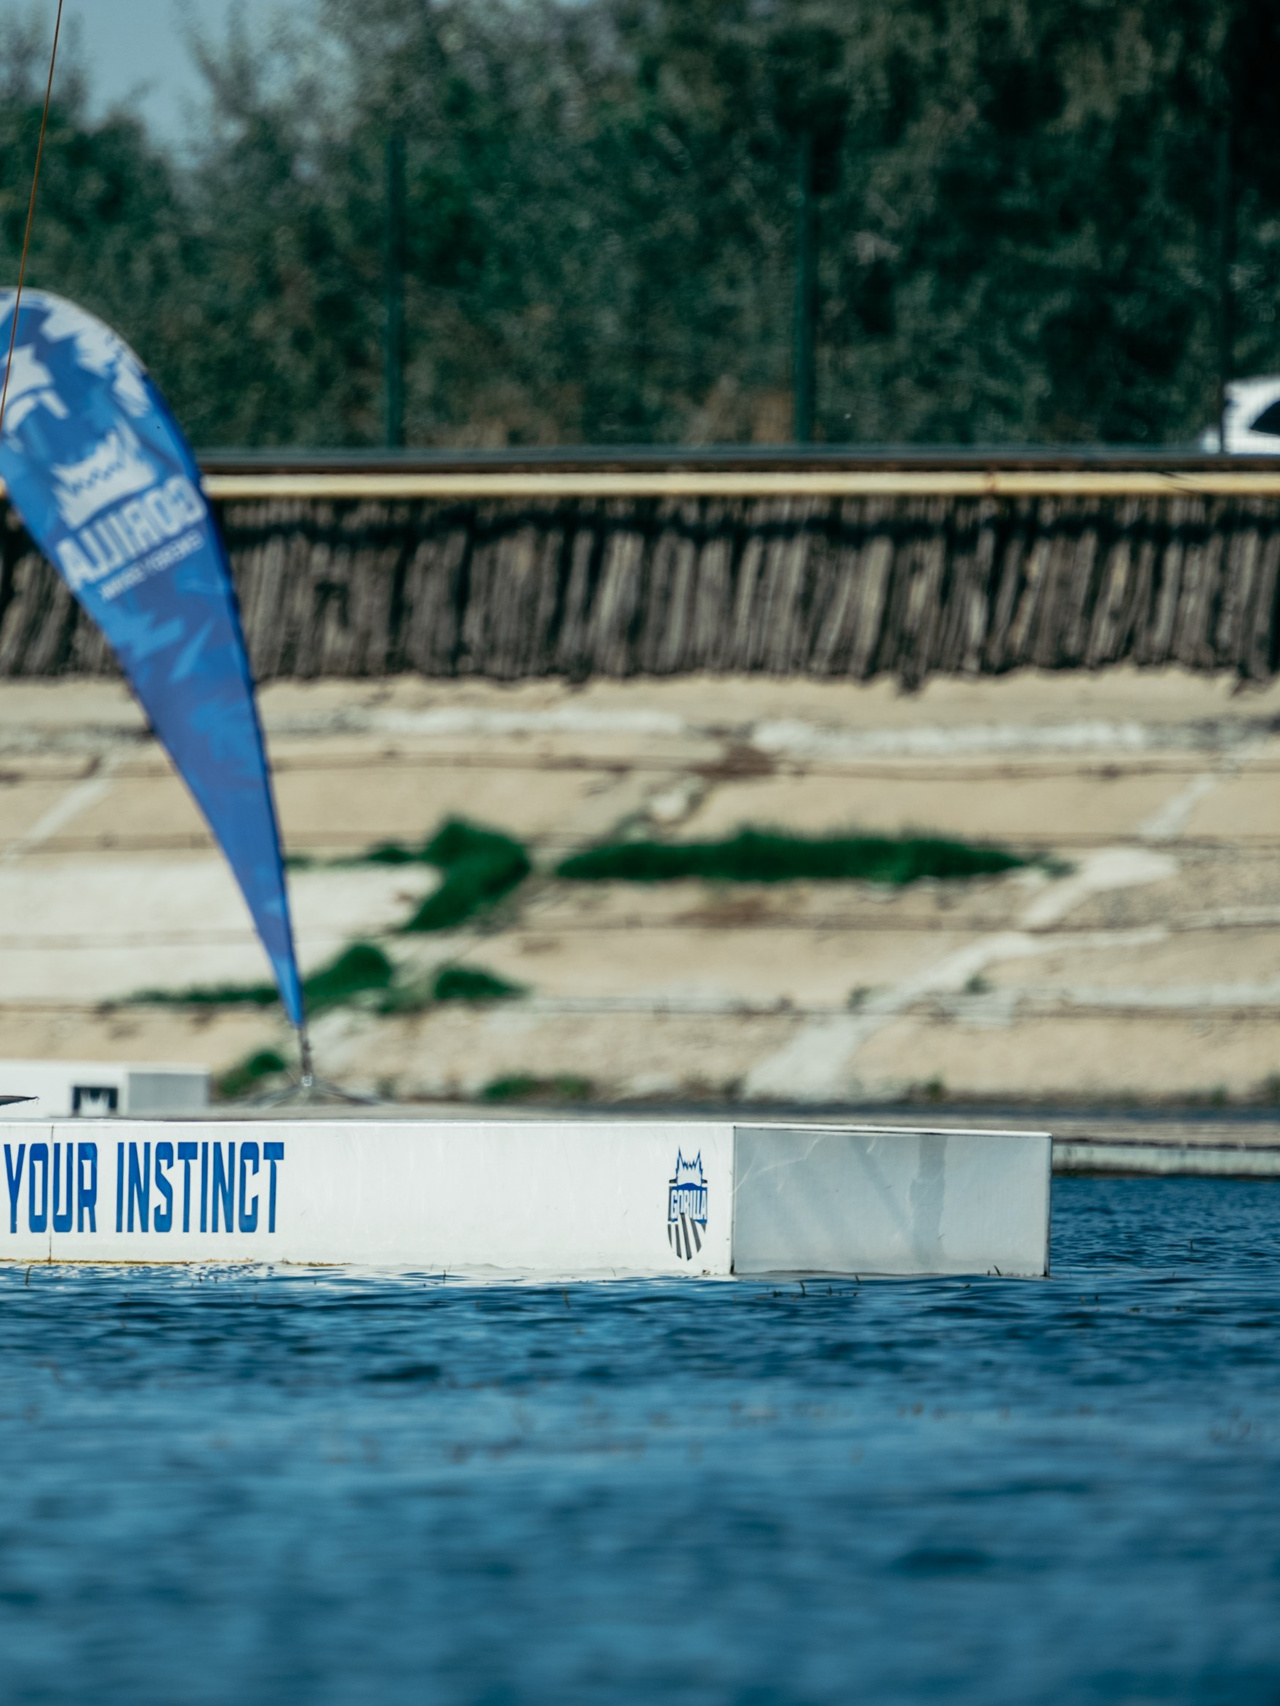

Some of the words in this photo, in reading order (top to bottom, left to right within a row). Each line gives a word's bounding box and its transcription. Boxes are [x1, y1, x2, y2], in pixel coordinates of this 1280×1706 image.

[4, 1141, 98, 1234] YOUR
[116, 1141, 285, 1234] INSTINCT
[671, 1189, 708, 1220] GORILLA
